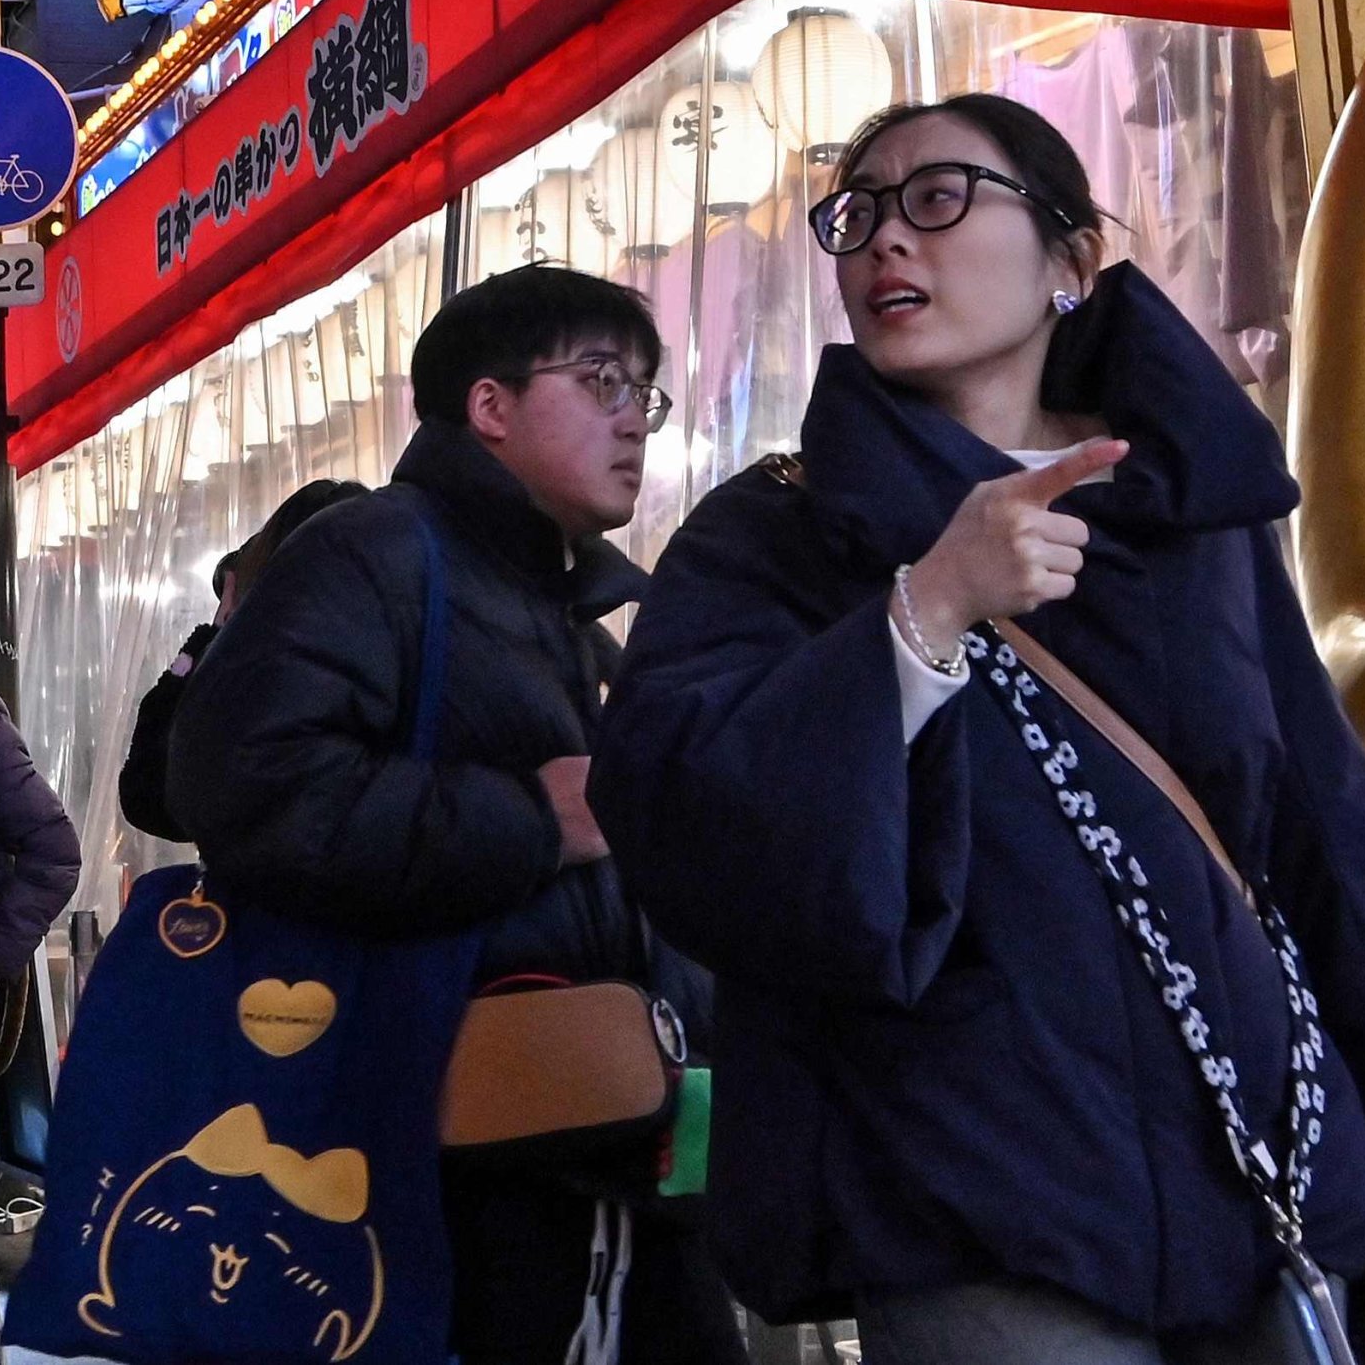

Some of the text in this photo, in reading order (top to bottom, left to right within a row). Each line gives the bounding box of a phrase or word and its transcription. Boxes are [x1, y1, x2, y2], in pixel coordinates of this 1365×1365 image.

[156, 112, 301, 273] 日本一の串かつ
